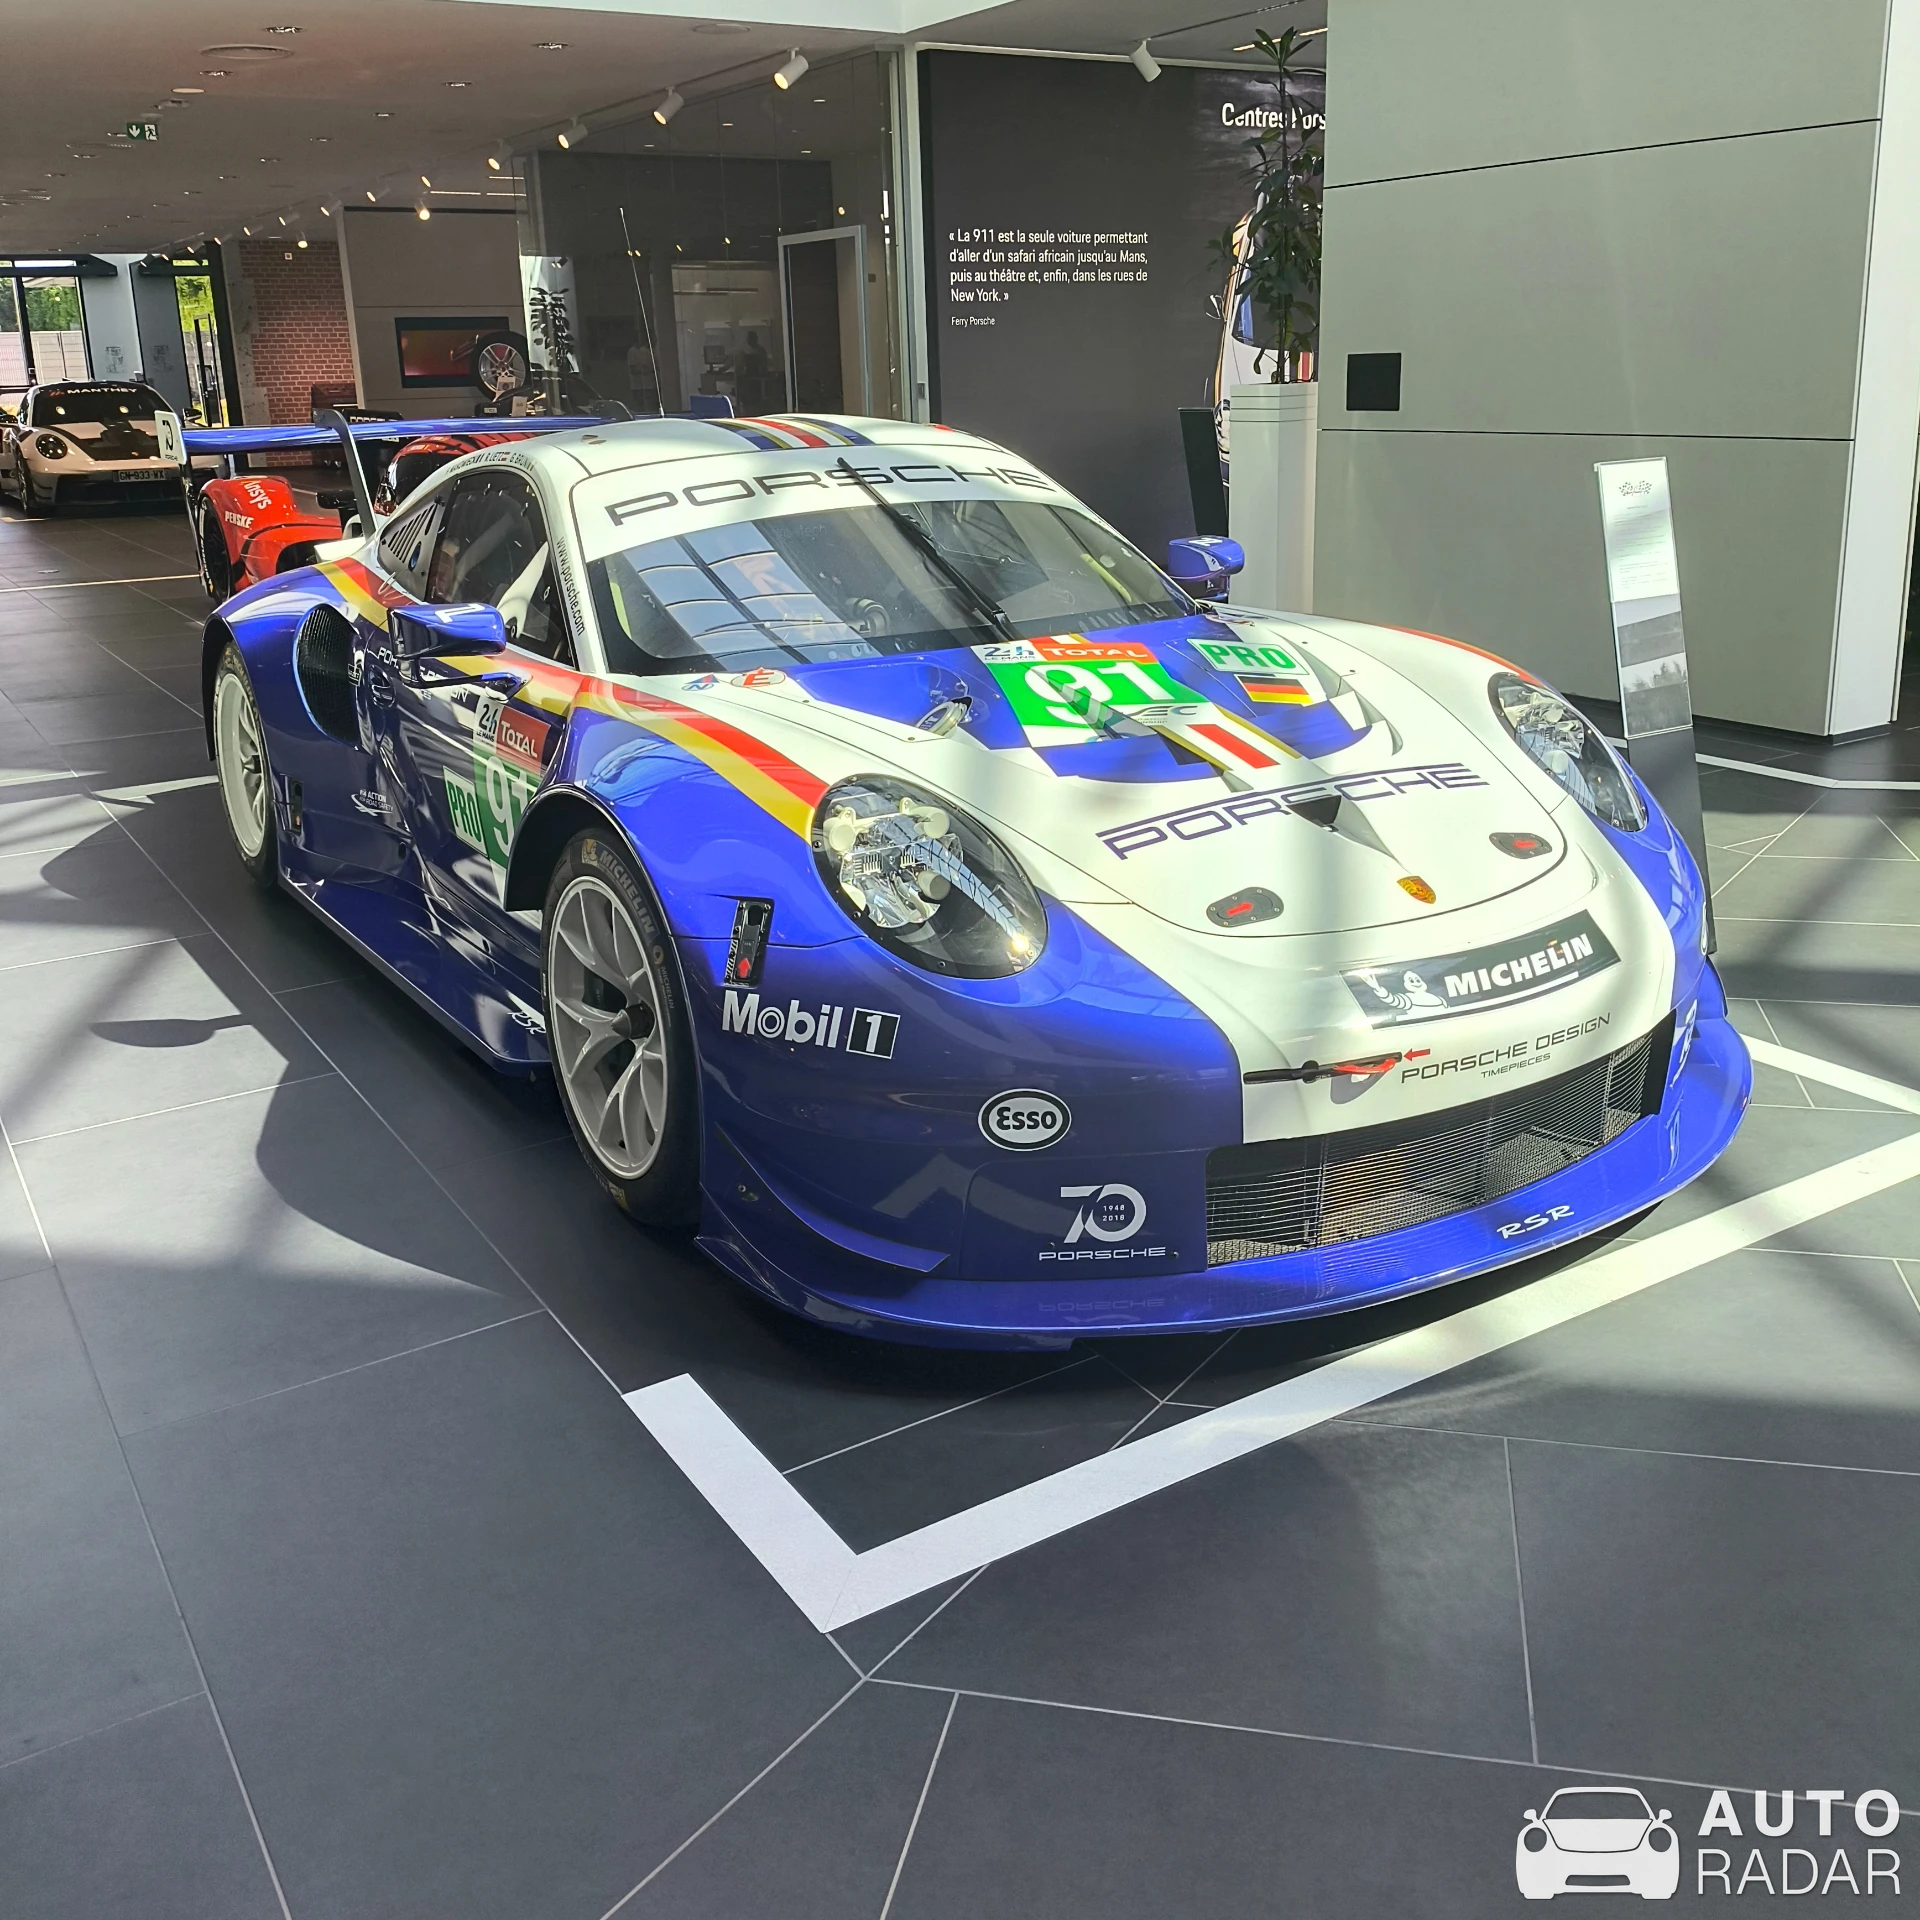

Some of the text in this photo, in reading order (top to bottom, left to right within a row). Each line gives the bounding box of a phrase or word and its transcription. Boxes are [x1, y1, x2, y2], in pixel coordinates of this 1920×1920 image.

[957, 229, 970, 242] La
[973, 229, 994, 242] 911
[998, 231, 1014, 243] est
[1017, 230, 1026, 243] la
[1028, 230, 1055, 243] seule
[1057, 231, 1091, 243] voiture
[1094, 231, 1148, 246] permettant
[950, 249, 1148, 266] d'aller d'un safari africain jusqu'au Mans,
[950, 269, 1148, 285] puis au théâtre et, enfin, dans les rues de
[951, 288, 974, 302] New
[976, 288, 1001, 302] York.
[951, 316, 996, 327] Ferry Porsche
[120, 470, 164, 481] GN-933-WX
[604, 465, 1057, 527] PORSCHE
[225, 511, 254, 529] PENSKE
[557, 536, 585, 636] www.porsche.com
[1199, 643, 1297, 669] PRO
[1025, 662, 1175, 728] 91
[368, 791, 387, 803] ACTION
[378, 802, 394, 811] SAFETY
[447, 780, 482, 842] PRO
[600, 850, 654, 934] MICHELIN
[1444, 932, 1594, 998] MICHELIN
[660, 965, 675, 1009] MICHELIN
[721, 990, 844, 1049] Mobil
[1401, 1012, 1611, 1084] PORSCHE DESIGN
[1481, 1053, 1551, 1079] TIMEPIECES
[996, 1106, 1058, 1132] Esso
[1060, 1183, 1147, 1243] 70
[1102, 1214, 1125, 1222] 2018
[1103, 1204, 1125, 1212] 1948
[1497, 1204, 1575, 1239] RSR
[1039, 1246, 1166, 1261] PORSCHE
